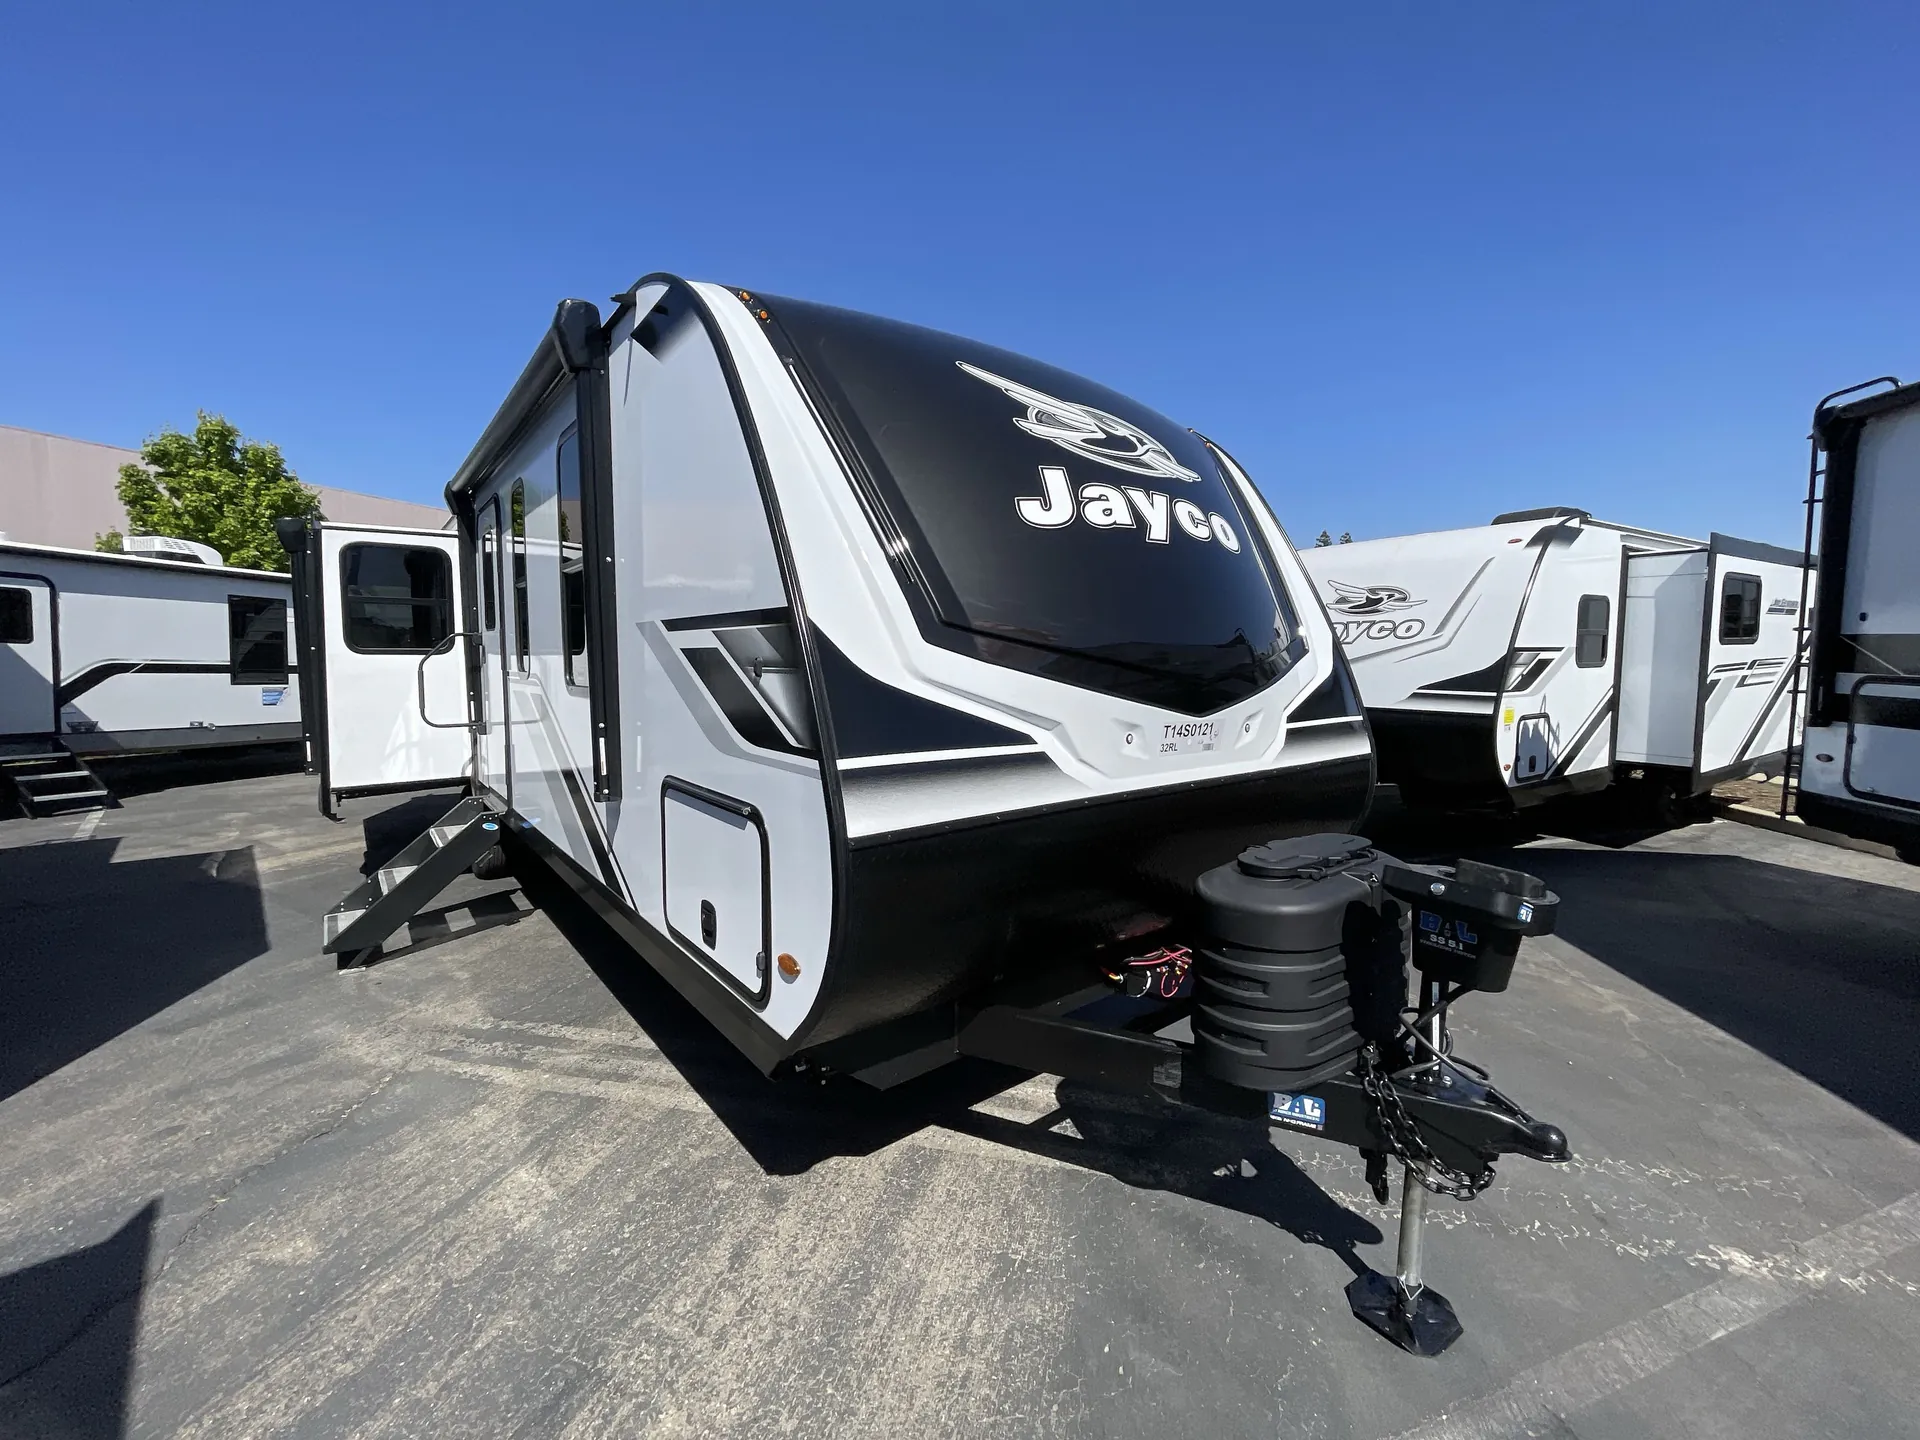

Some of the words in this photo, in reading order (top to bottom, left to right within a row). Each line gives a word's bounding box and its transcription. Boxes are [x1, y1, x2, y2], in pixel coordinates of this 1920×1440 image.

[1014, 465, 1241, 555] Jayco
[1163, 722, 1215, 739] T14S0121
[1159, 742, 1178, 753] 32RL
[1272, 1092, 1322, 1118] BAL
